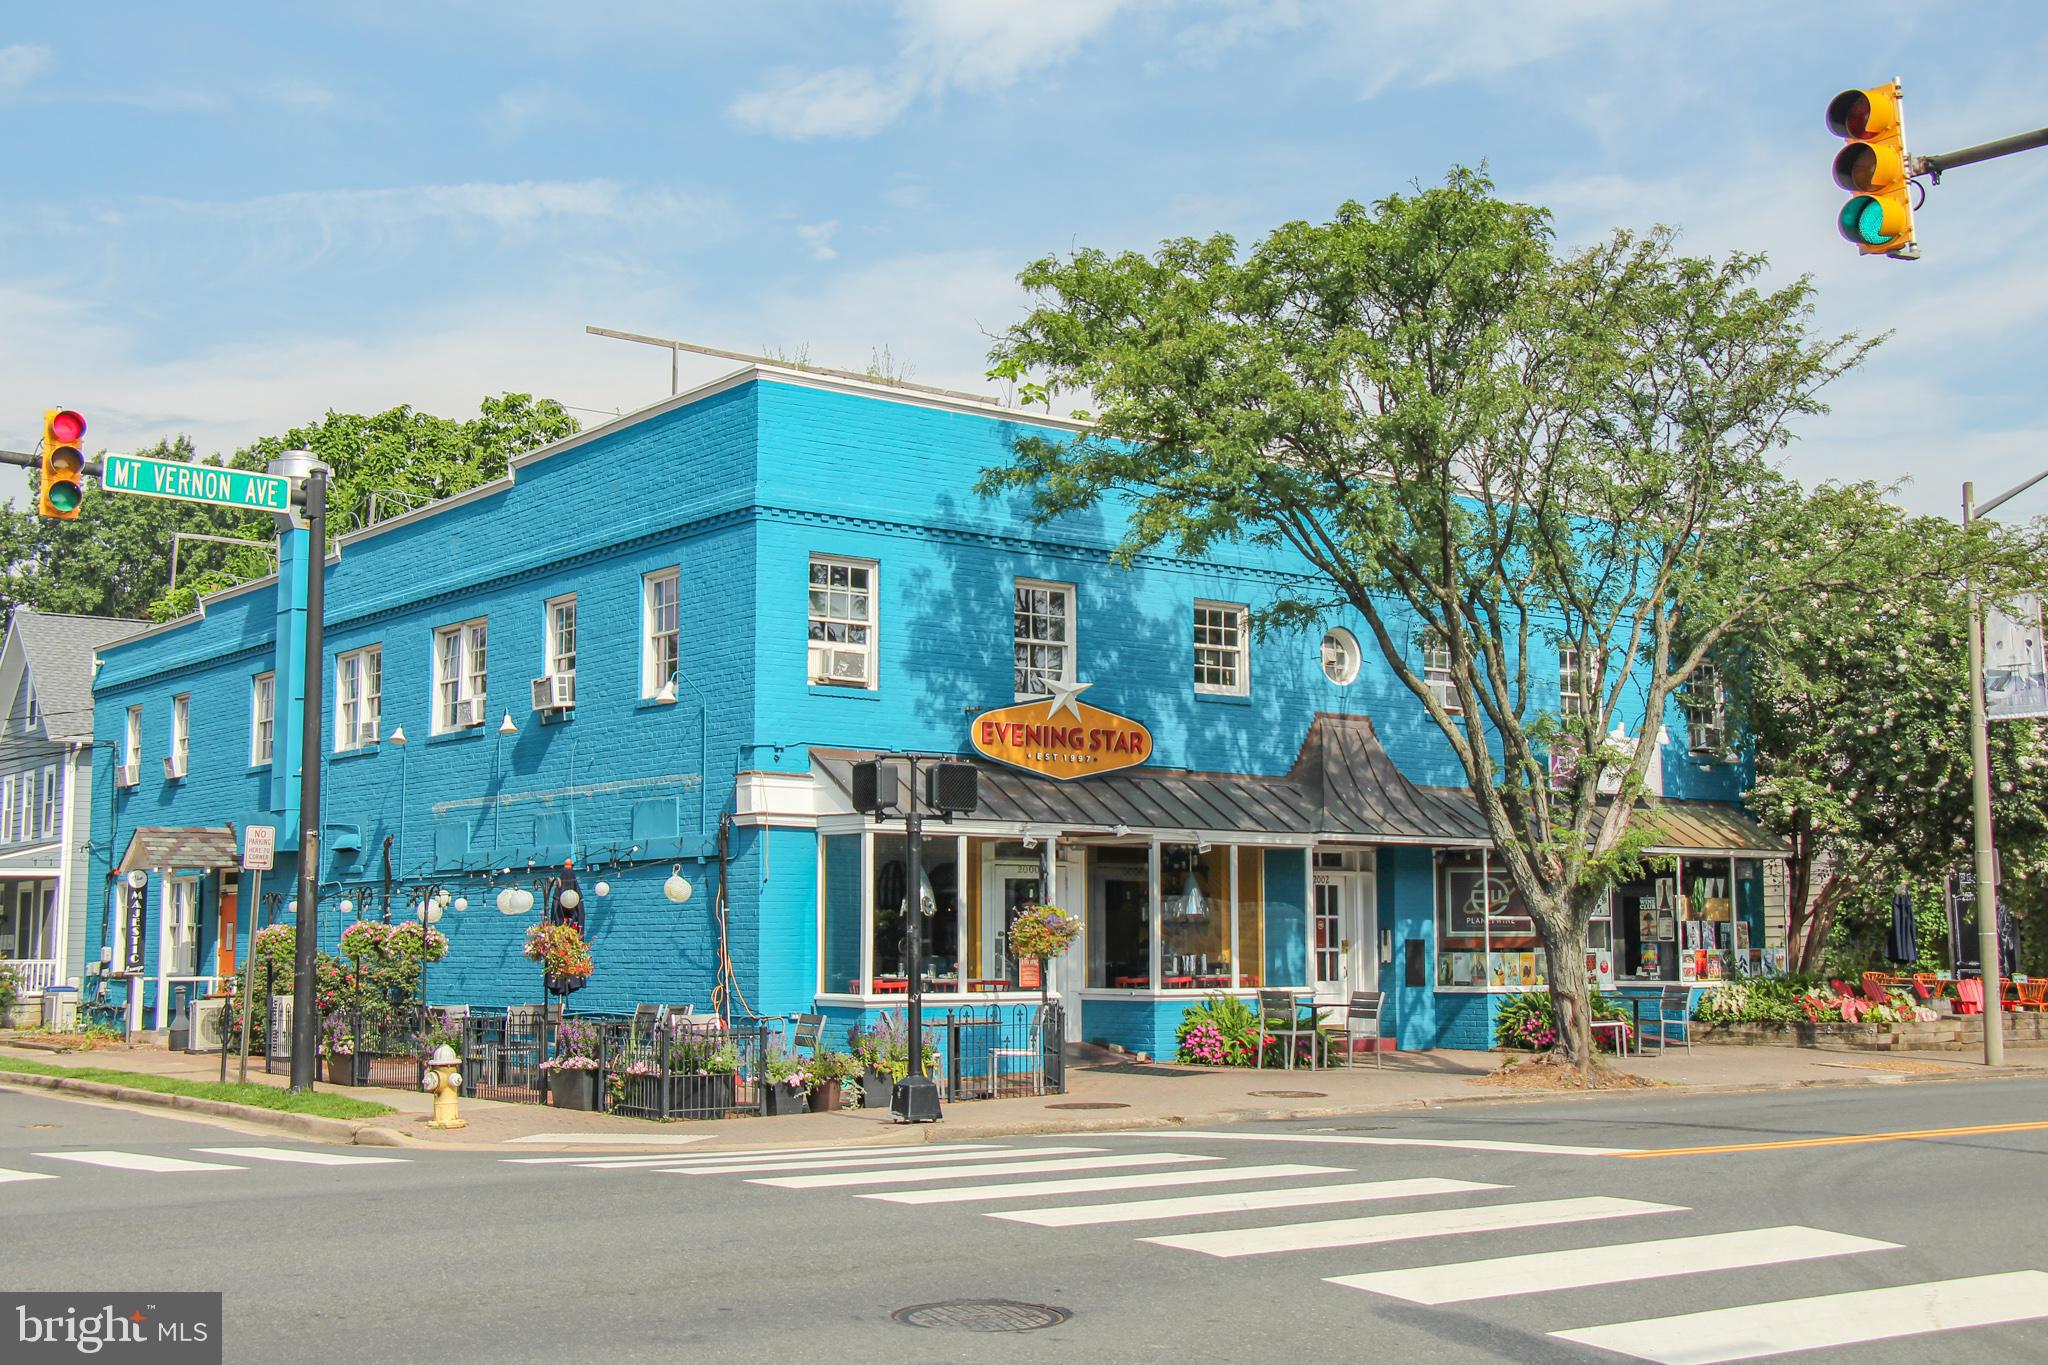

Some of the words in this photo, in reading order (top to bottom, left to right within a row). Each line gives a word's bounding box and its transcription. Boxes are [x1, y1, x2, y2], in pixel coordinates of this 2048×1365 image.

[114, 459, 141, 488] MT
[154, 464, 231, 500] VERNON
[245, 478, 278, 506] AVE
[981, 721, 1085, 751] EVENING
[1089, 728, 1144, 753] STAR
[1036, 752, 1058, 761] EST
[1064, 754, 1091, 762] 1997
[255, 830, 267, 838] NO
[1313, 875, 1330, 883] 2002
[131, 891, 144, 963] MAJESTIC
